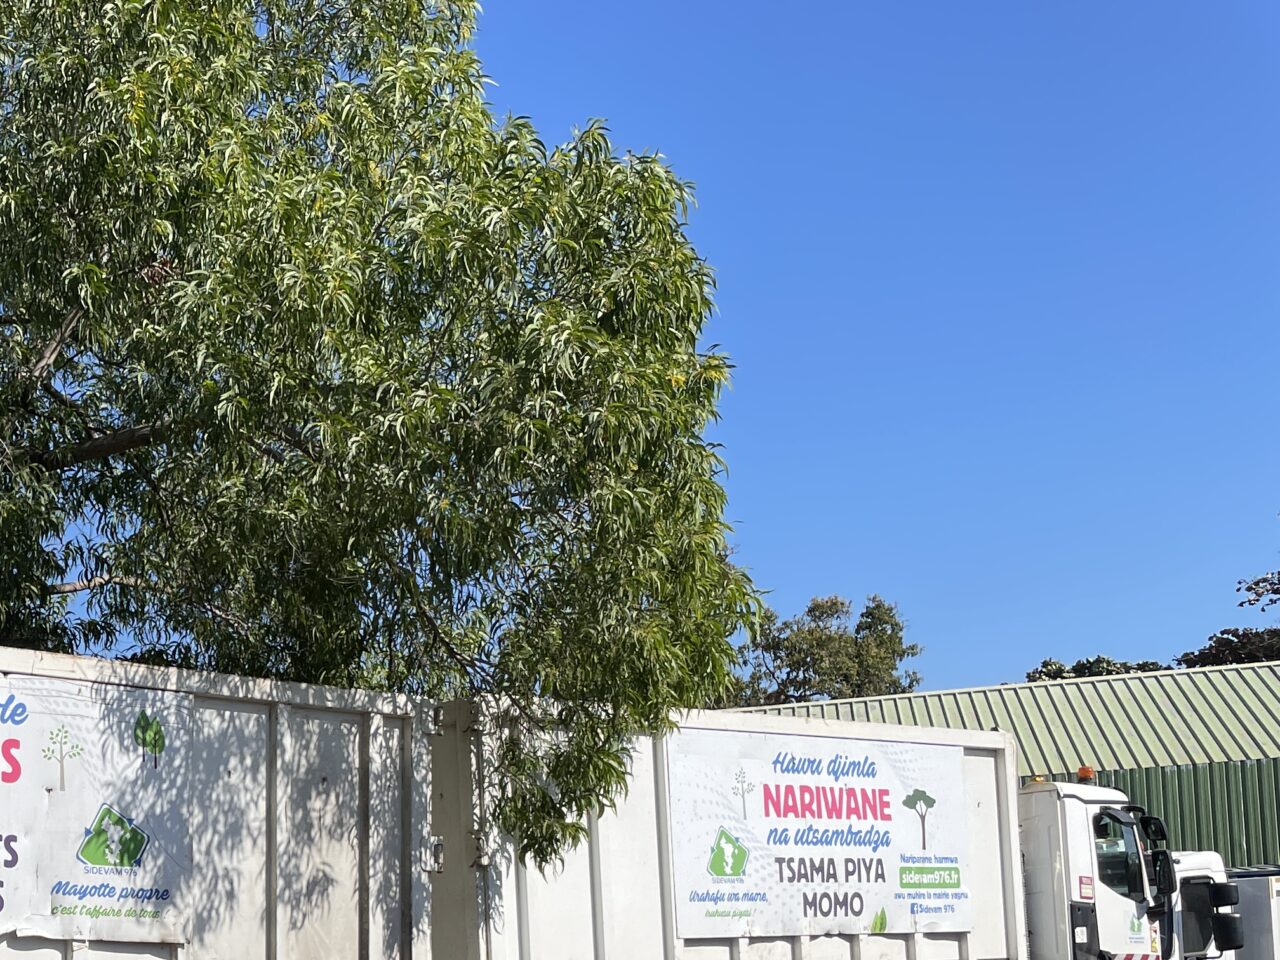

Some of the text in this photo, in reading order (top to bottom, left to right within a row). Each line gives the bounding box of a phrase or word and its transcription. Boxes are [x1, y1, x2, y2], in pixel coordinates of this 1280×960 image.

[763, 783, 892, 821] NARIWANE
[767, 824, 892, 853] na utsambadza
[83, 866, 123, 876] SIDEVAM
[774, 857, 886, 883] TSAMA PIYA
[50, 880, 170, 903] Mayotte propre
[802, 891, 864, 918] MOMO
[51, 904, 78, 916] c'est
[79, 904, 122, 919] l'affaire
[124, 907, 137, 918] de
